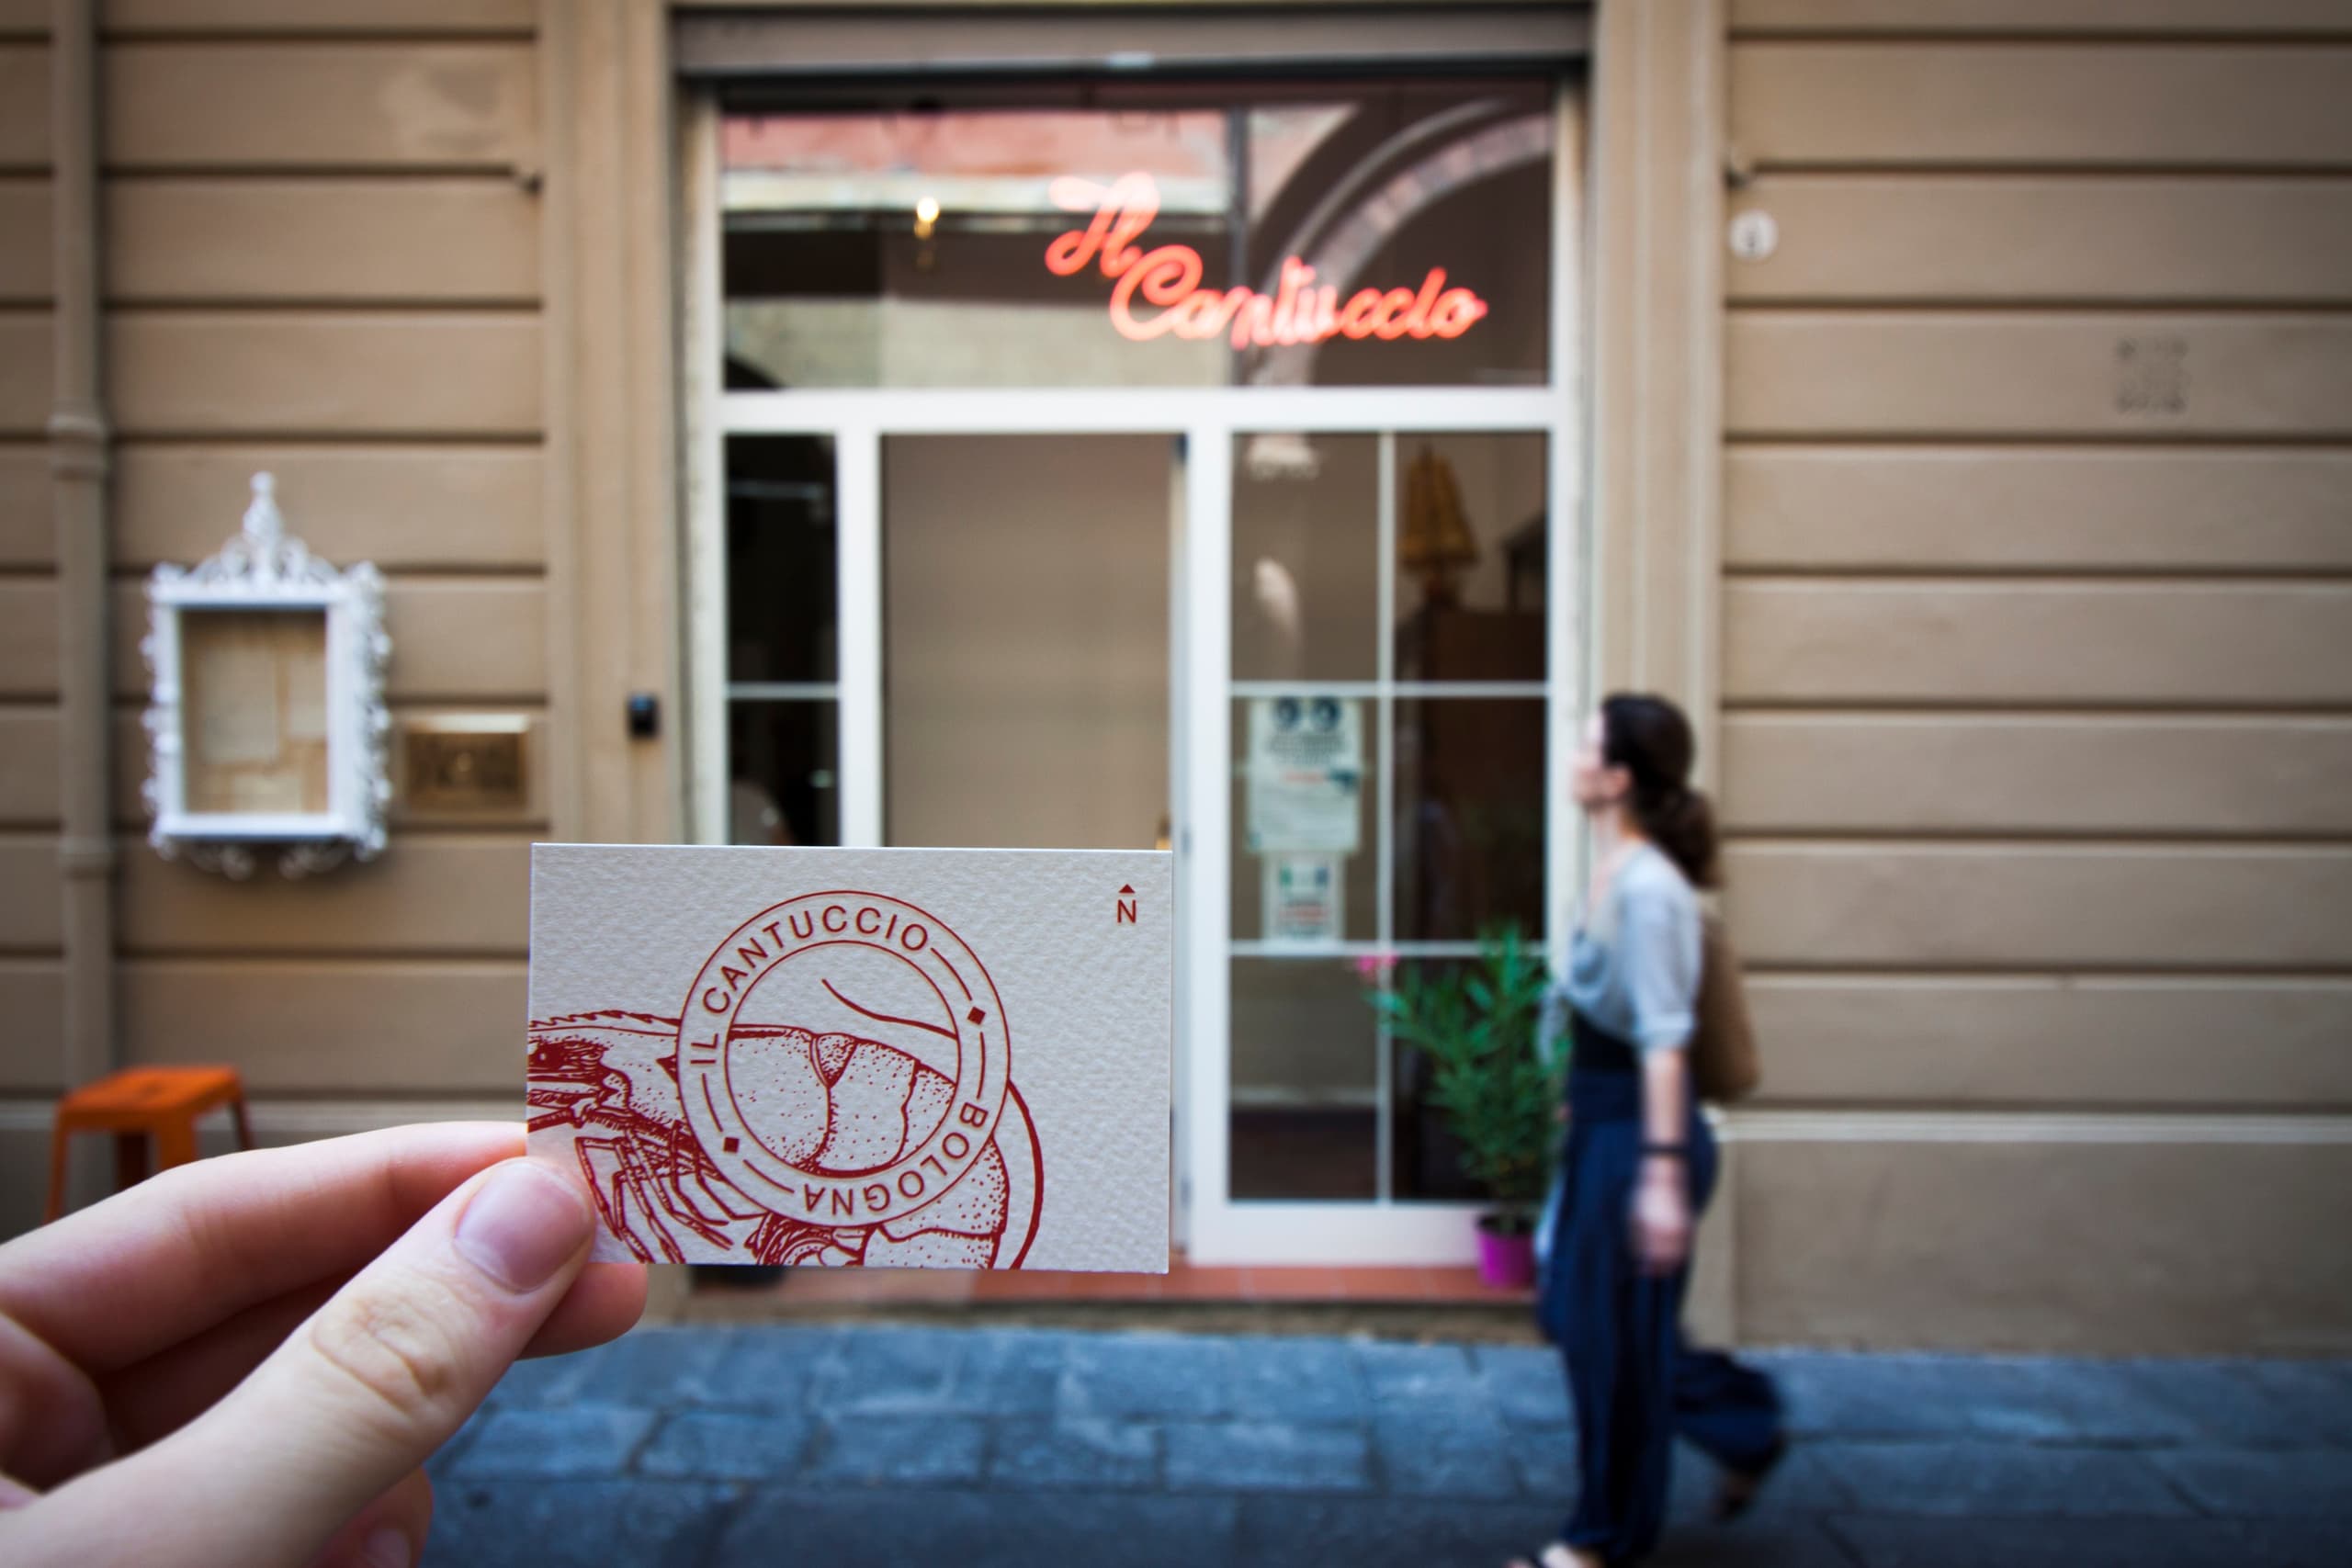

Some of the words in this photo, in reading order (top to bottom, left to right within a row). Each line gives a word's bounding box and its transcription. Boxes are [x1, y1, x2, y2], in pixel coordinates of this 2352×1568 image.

[1046, 172, 1159, 276] Il
[1110, 245, 1487, 348] Cantuccio
[702, 905, 929, 1014] CANTUCCIO
[1116, 899, 1136, 923] N
[692, 1032, 719, 1066] IL
[804, 1101, 989, 1215] BOLOGNA
